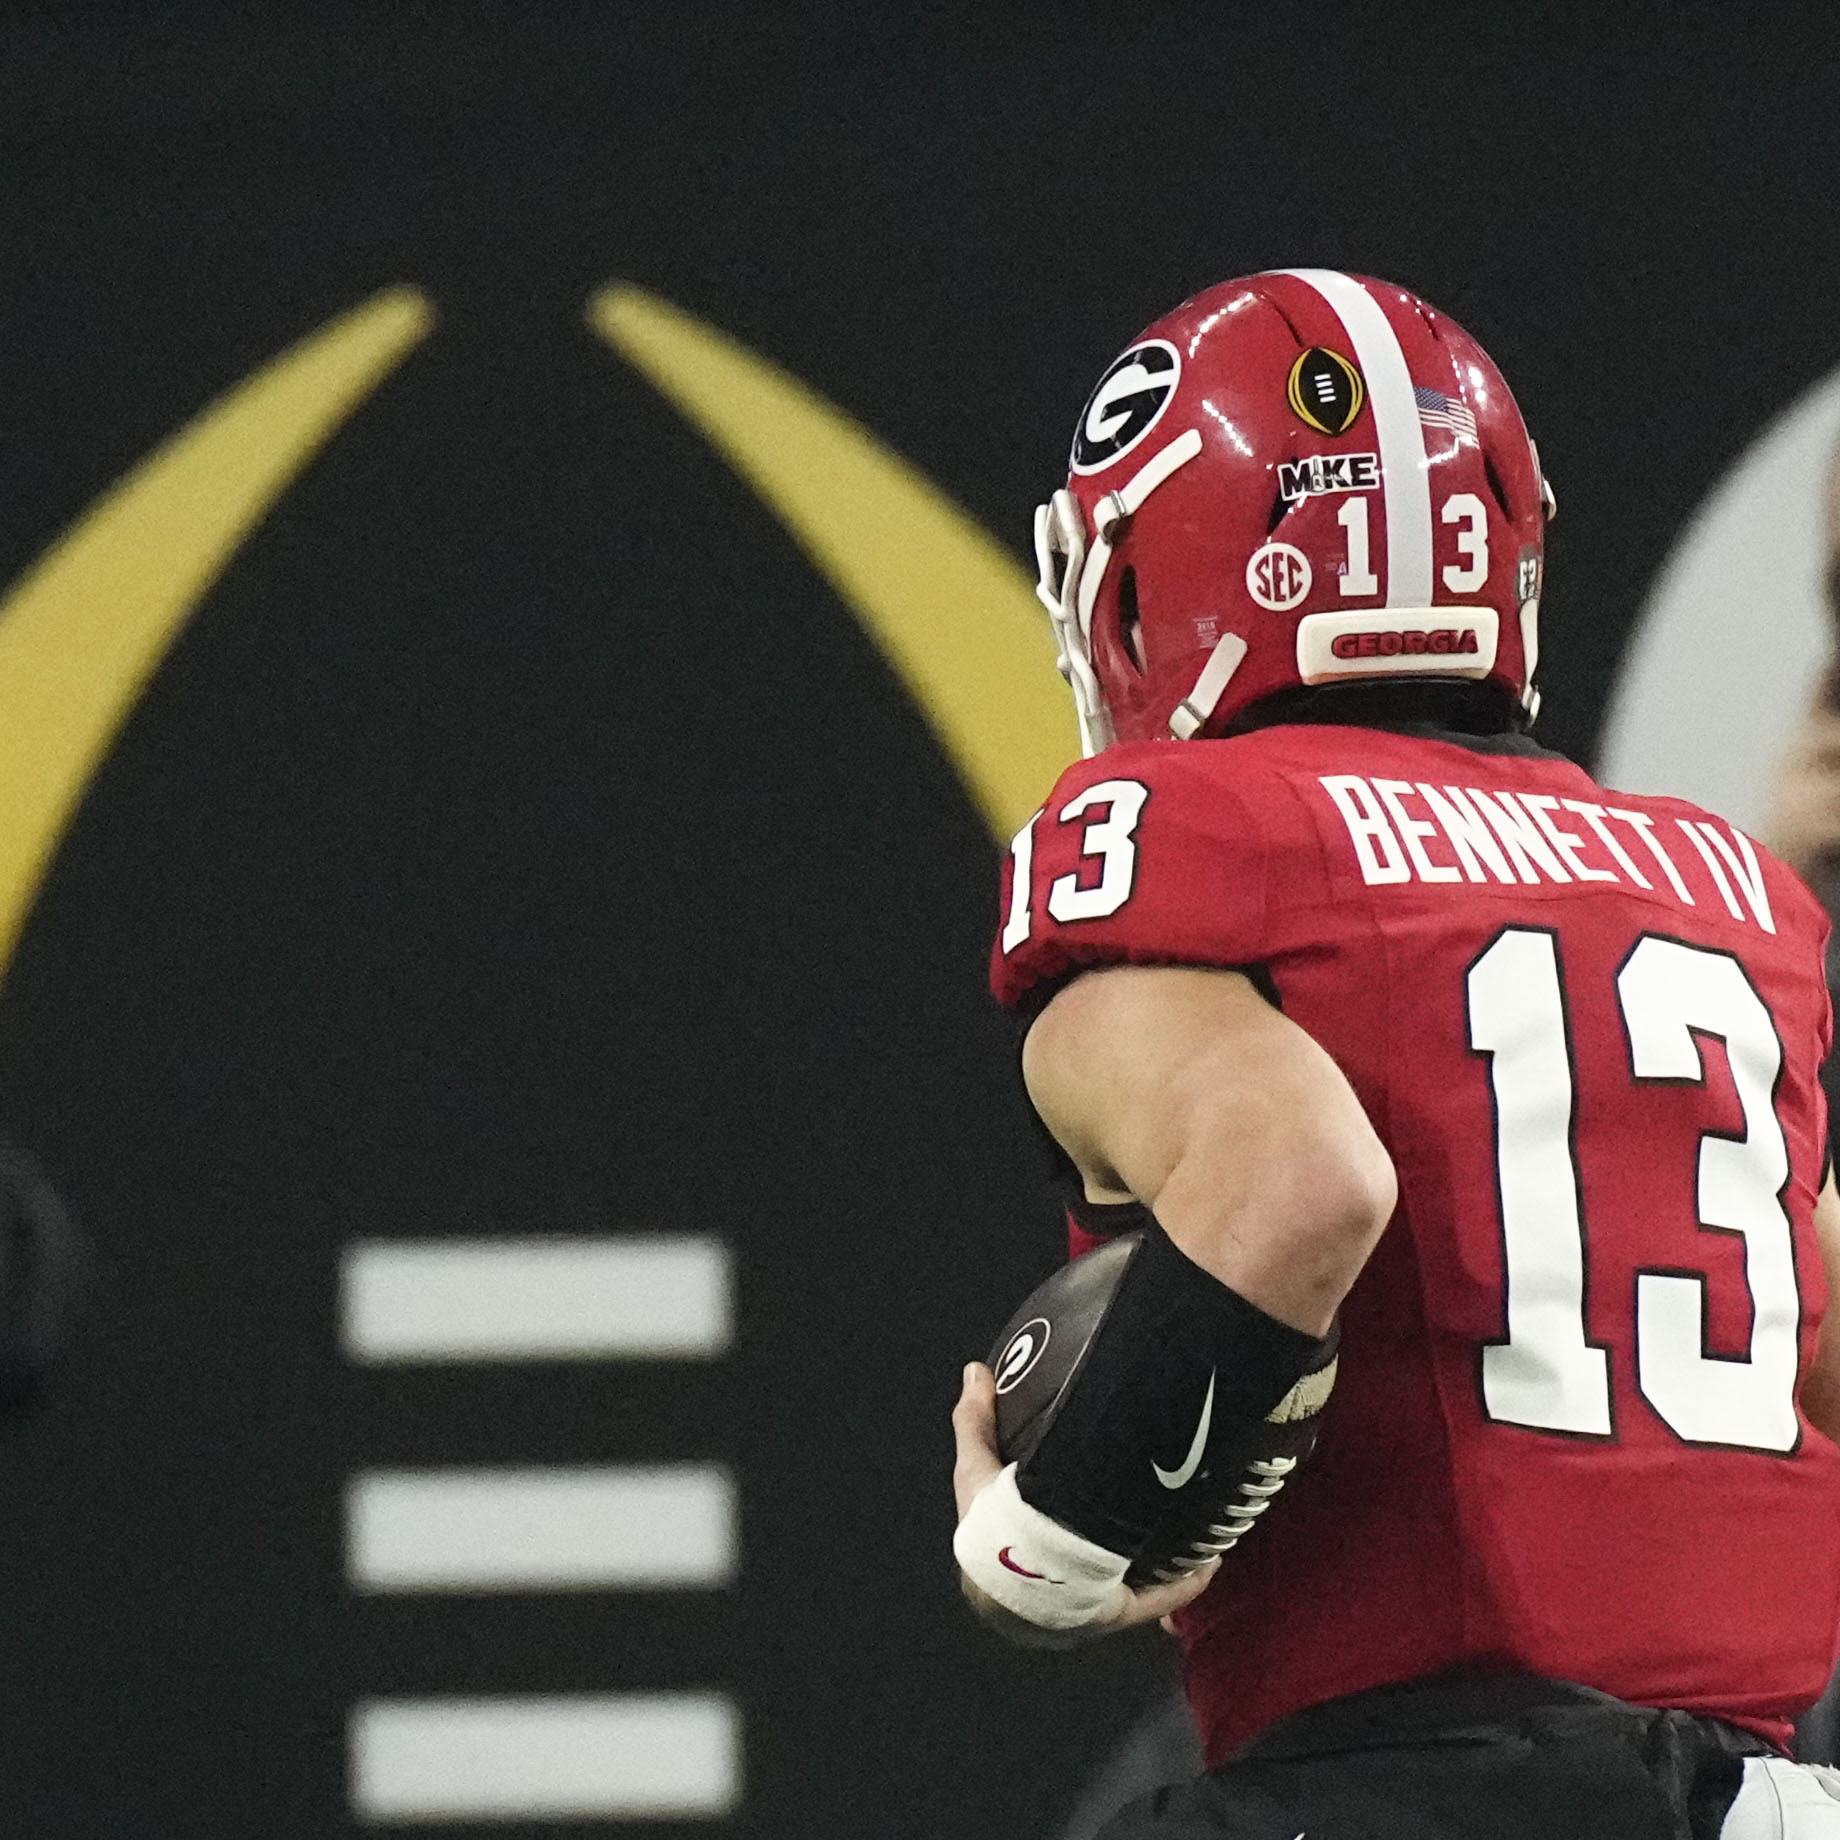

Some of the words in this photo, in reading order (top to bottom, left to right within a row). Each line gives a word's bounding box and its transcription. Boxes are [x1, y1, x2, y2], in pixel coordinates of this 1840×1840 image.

[1253, 550, 1305, 604] SEC
[1330, 628, 1480, 660] GEORGIA
[998, 777, 1151, 956] 13
[1317, 772, 1695, 908] BENNETT
[1685, 820, 1778, 936] IV
[1463, 924, 1802, 1456] 13
